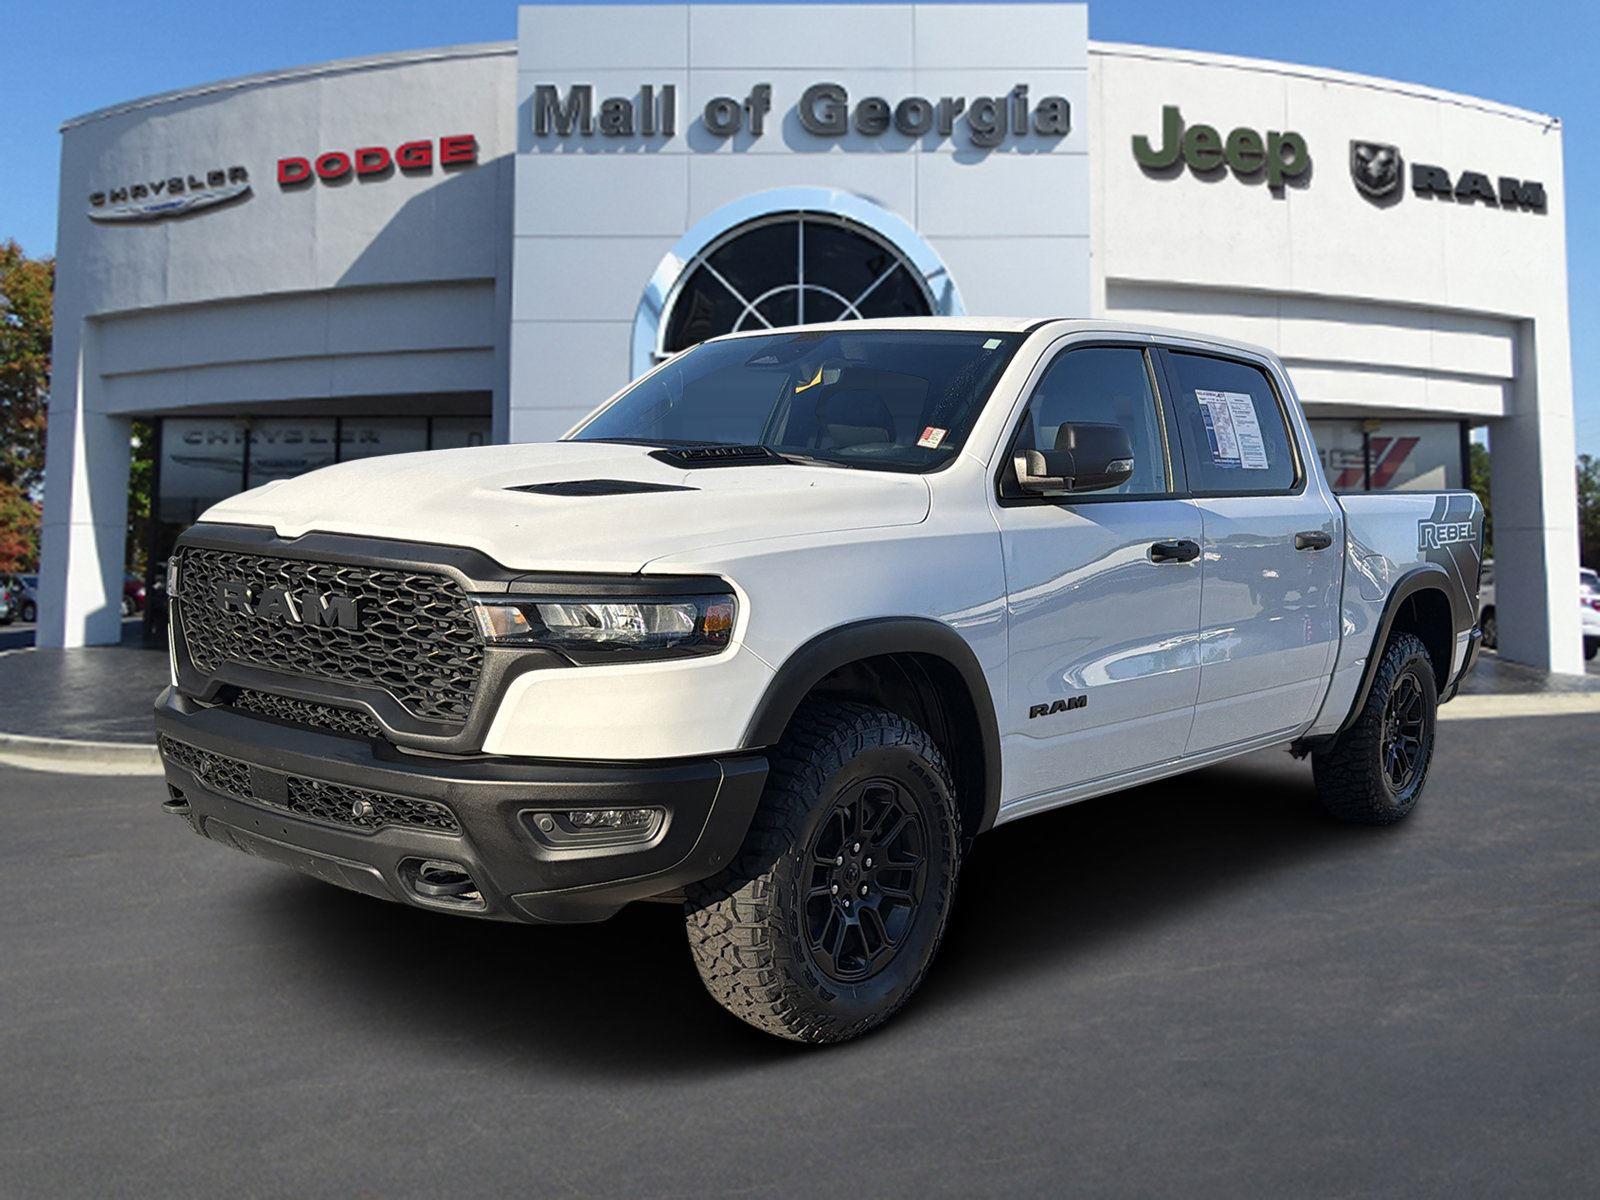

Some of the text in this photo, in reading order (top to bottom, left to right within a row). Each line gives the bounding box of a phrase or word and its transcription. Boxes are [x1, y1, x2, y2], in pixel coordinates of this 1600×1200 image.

[533, 82, 1071, 148] Mall of Georgia
[277, 134, 476, 185] DODGE
[1132, 105, 1309, 188] Jeep
[90, 166, 249, 207] CHRYSLER
[1411, 163, 1547, 212] RAM
[1419, 522, 1477, 549] REBEL
[216, 580, 357, 630] RAM
[1029, 695, 1087, 719] RAM
